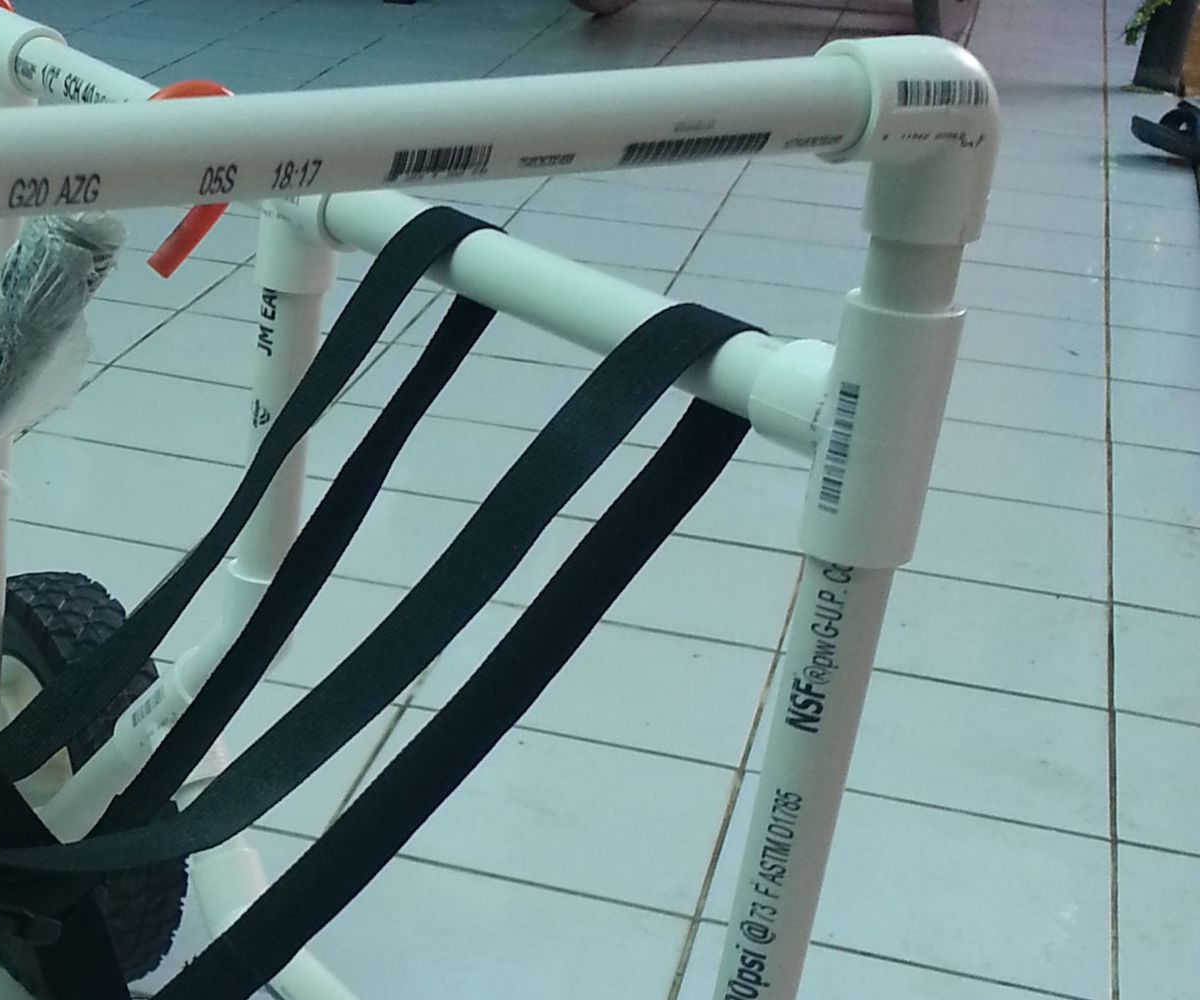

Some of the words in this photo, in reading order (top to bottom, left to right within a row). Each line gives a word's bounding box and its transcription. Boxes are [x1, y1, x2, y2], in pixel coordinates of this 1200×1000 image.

[8, 177, 50, 208] G20
[55, 172, 101, 205] AZG
[270, 158, 322, 191] 18:17
[257, 325, 274, 357] JM
